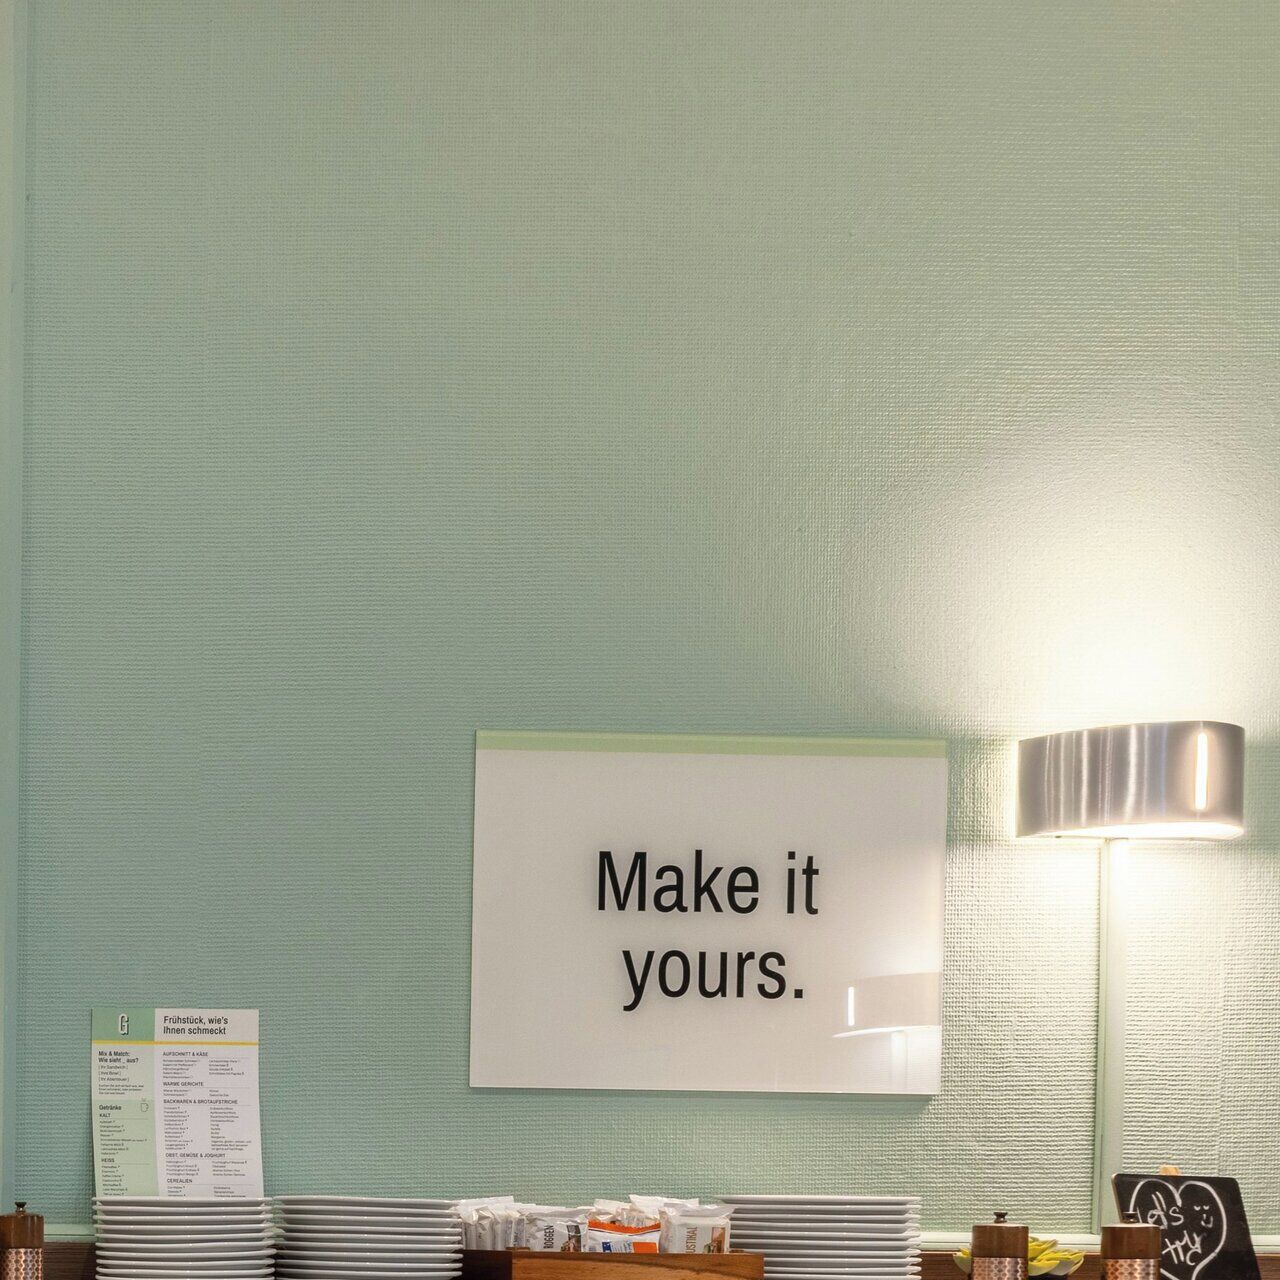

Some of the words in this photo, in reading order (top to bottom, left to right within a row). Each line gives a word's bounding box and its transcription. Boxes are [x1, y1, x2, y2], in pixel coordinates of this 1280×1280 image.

[597, 849, 760, 915] Make
[786, 850, 820, 915] it
[621, 949, 804, 1012] yours.
[163, 1015, 206, 1025] Frühstück,
[207, 1015, 229, 1024] wie's
[163, 1026, 186, 1035] Ihnen
[187, 1026, 226, 1035] schmeckt
[543, 1224, 555, 1249] ROGGEN
